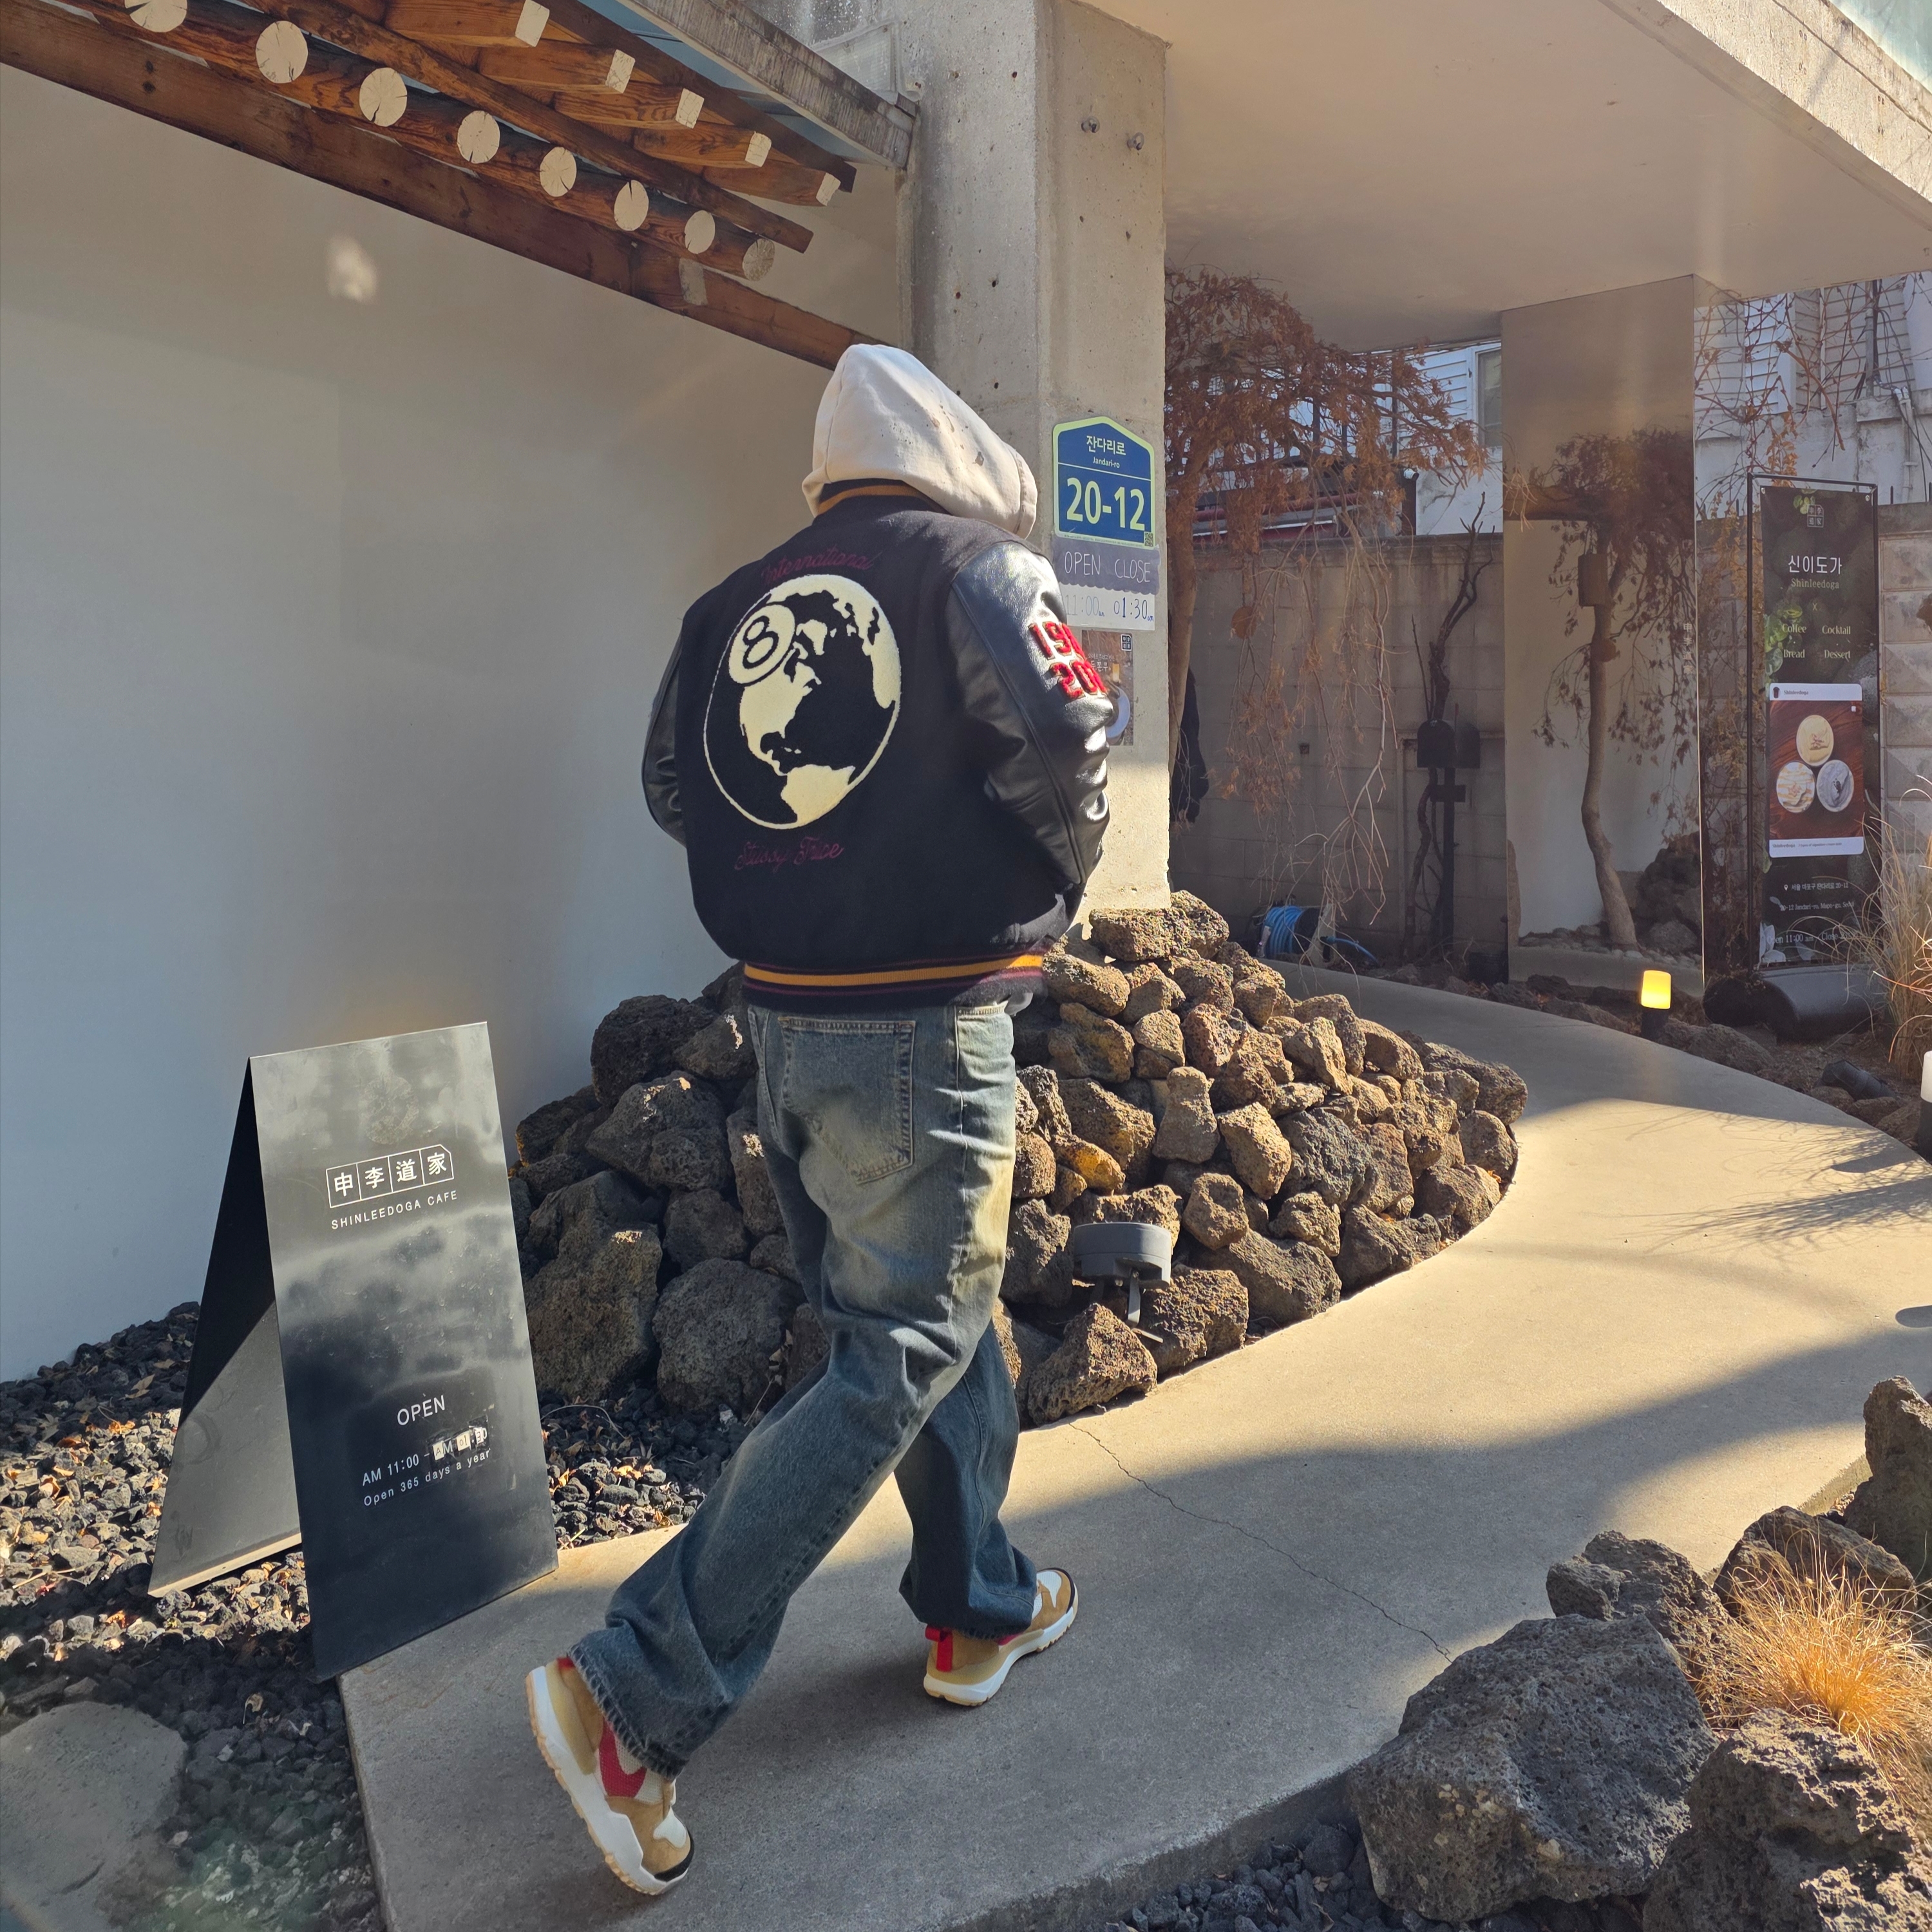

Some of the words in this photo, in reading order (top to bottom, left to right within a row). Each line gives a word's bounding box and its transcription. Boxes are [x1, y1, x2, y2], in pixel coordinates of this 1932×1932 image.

[1086, 435, 1126, 455] 잔다리로
[1093, 457, 1120, 468] Jandari-ro
[1066, 477, 1145, 531] 20-12
[1065, 551, 1101, 575] OPEN
[1115, 559, 1151, 583] CLOSE
[1788, 555, 1842, 575] 신이도가
[1791, 578, 1839, 590] Shinleedoga
[743, 616, 779, 669] 8
[1782, 624, 1807, 633] Coffee
[1822, 625, 1851, 635] Cocktail
[1783, 649, 1805, 658] Bread
[1824, 649, 1851, 662] Dessert
[1791, 883, 1801, 891] 서울
[1786, 933, 1804, 943] 11:00
[334, 1151, 447, 1197] 申李道家
[331, 1199, 421, 1230] SHINLEEDOGA
[427, 1189, 457, 1206] CAFE
[397, 1394, 446, 1426] OPEN
[362, 1468, 382, 1486] AM
[387, 1454, 419, 1476] 11:00
[364, 1488, 394, 1506] Open
[401, 1477, 419, 1492] 365
[425, 1465, 450, 1482] days
[456, 1462, 462, 1470] a
[467, 1449, 489, 1468] year
